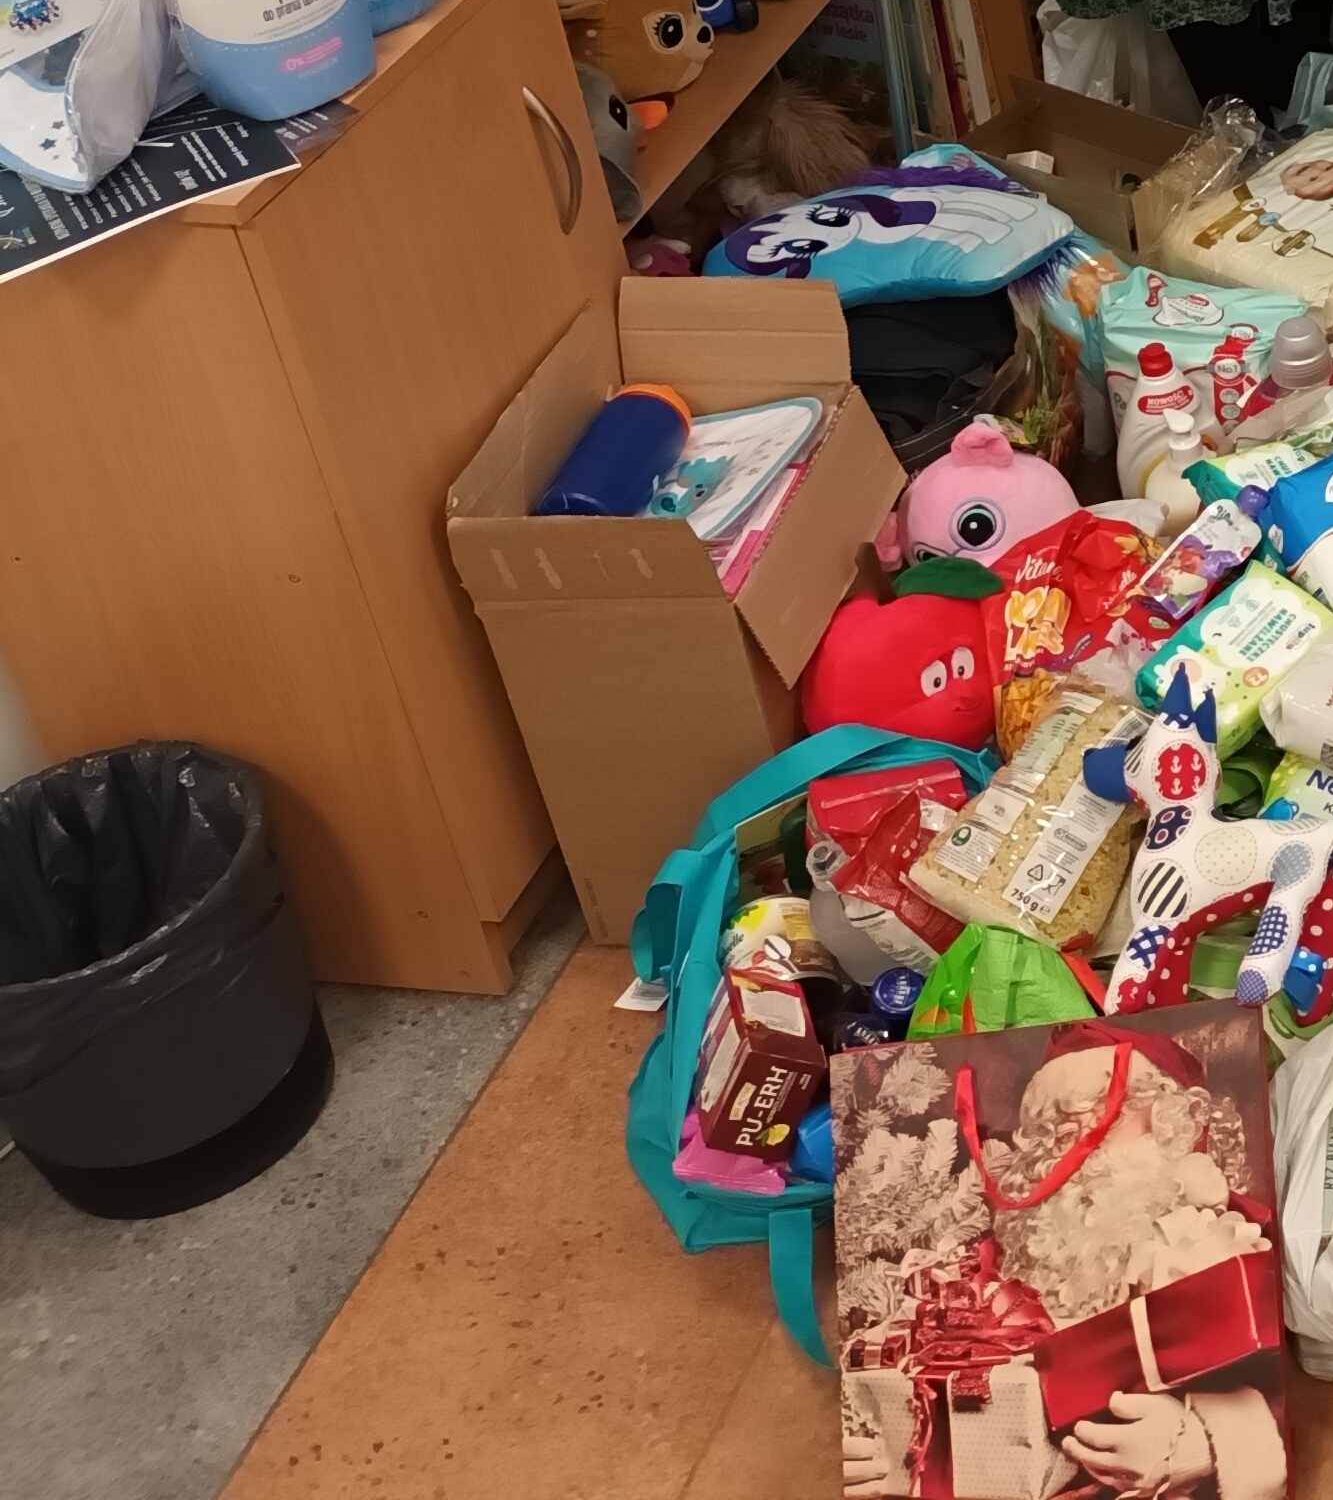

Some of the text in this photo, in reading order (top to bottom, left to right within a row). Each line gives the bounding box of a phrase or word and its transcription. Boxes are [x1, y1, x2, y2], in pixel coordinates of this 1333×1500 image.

[263, 8, 275, 23] do
[1216, 364, 1239, 374] No.1
[1239, 608, 1289, 658] NAWILŻANE
[1246, 613, 1297, 663] CHUSTECZKI
[736, 1065, 789, 1147] PU-ERH
